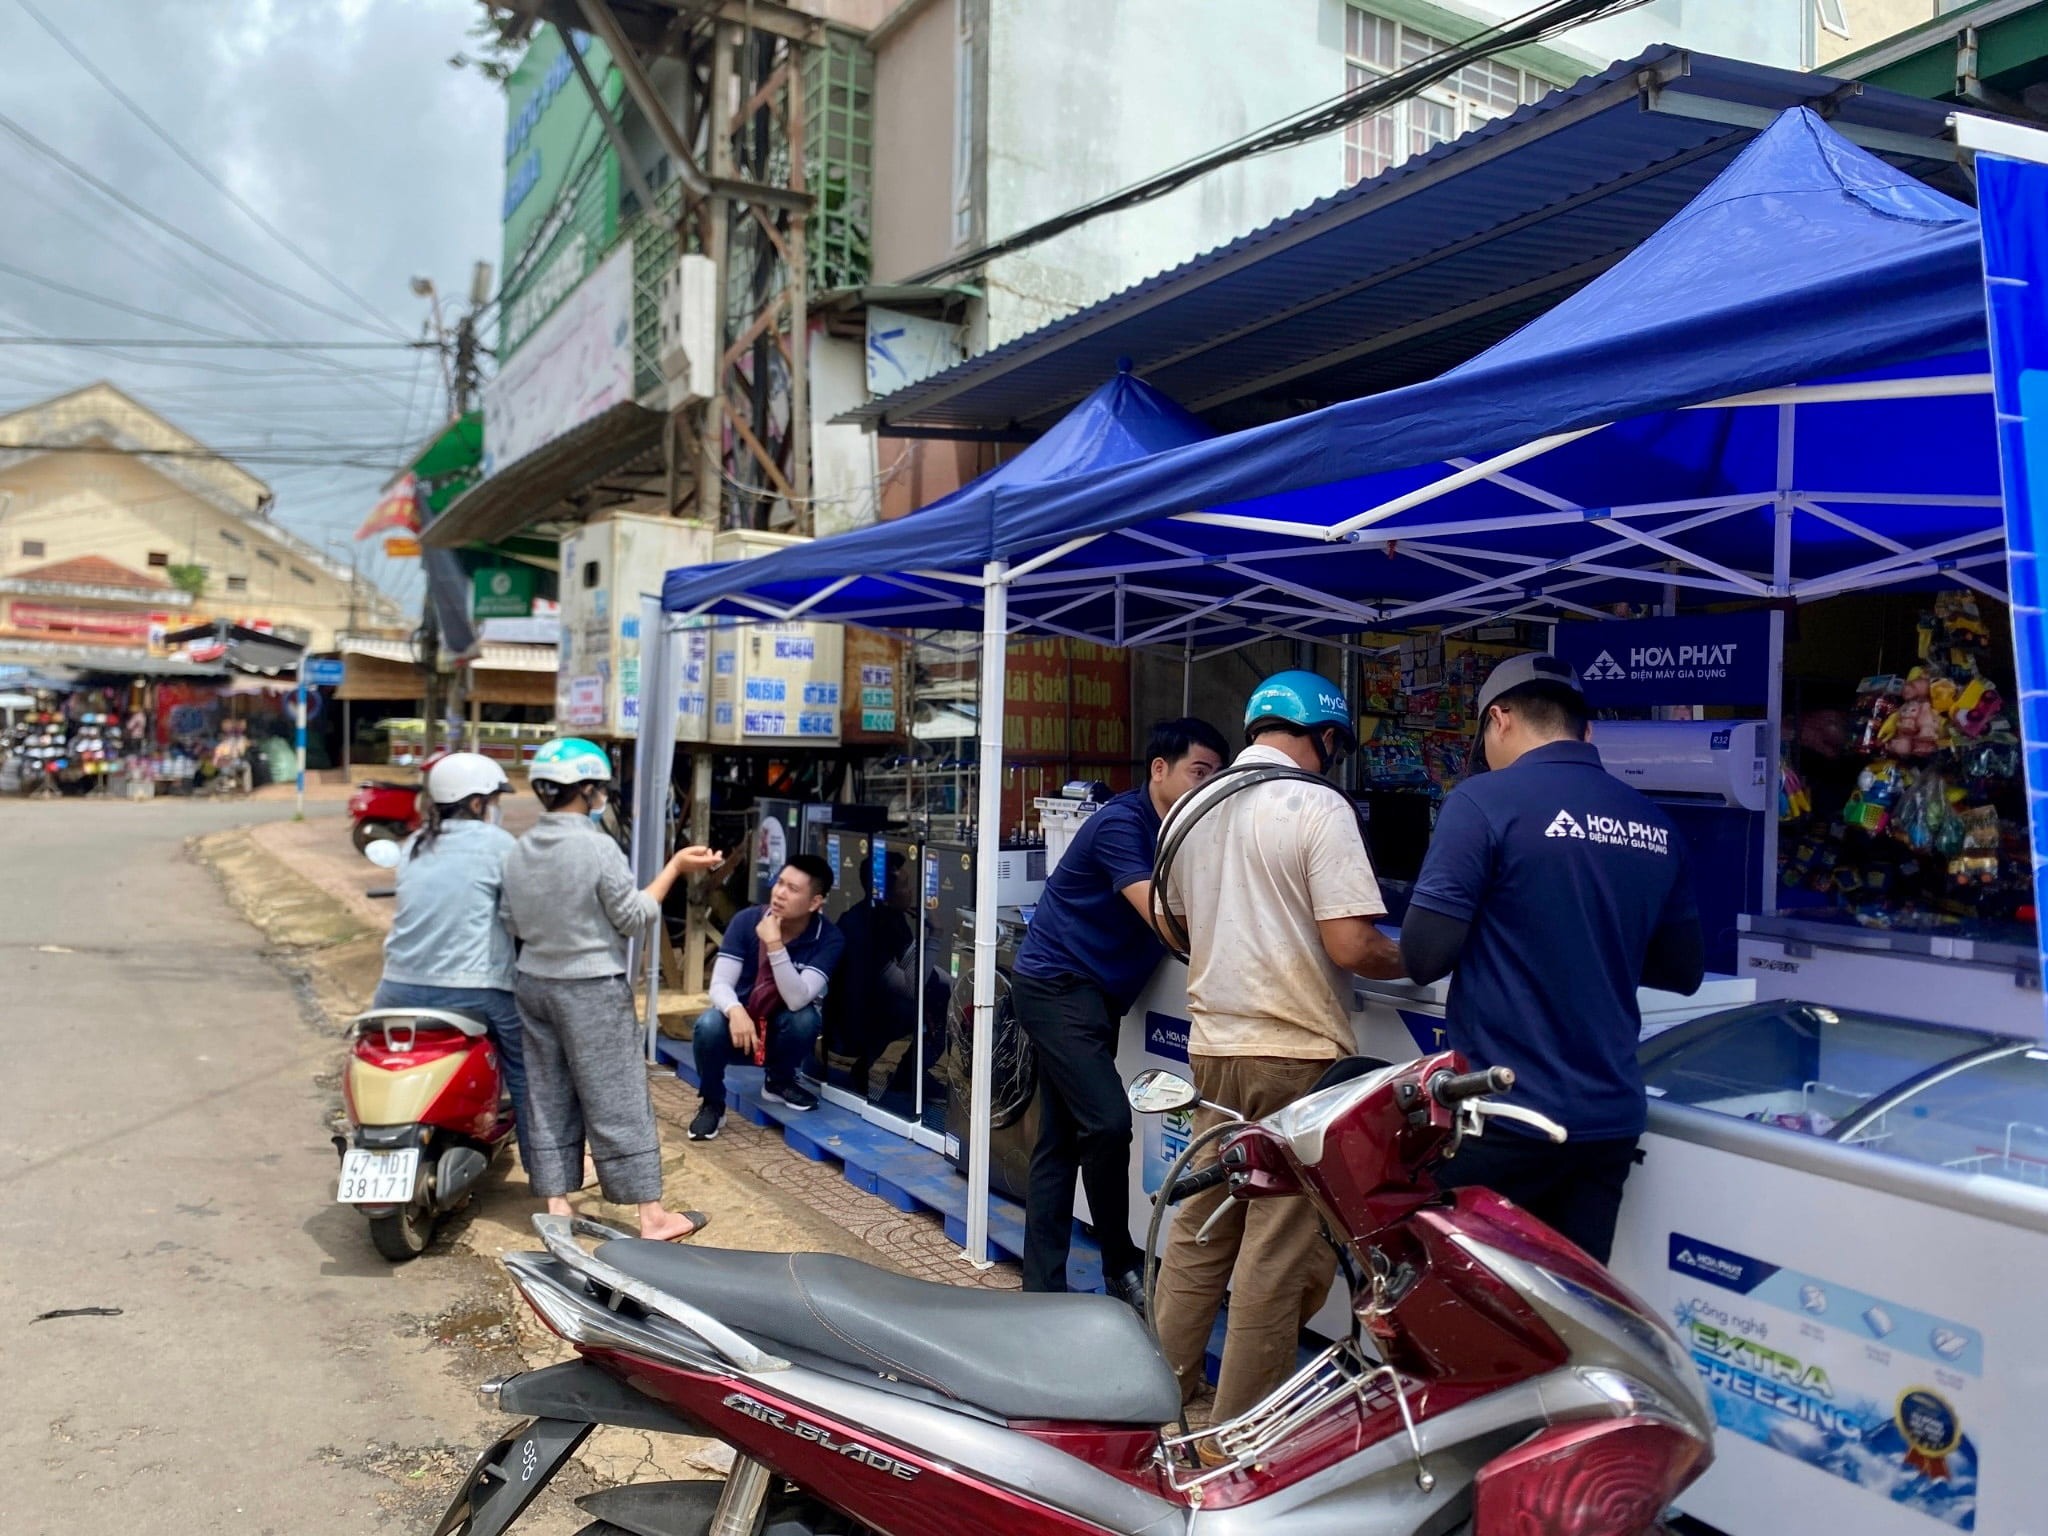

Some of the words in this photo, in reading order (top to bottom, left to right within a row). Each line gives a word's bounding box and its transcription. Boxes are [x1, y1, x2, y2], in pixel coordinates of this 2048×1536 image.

[1630, 669, 1652, 682] ĐIỆN
[1655, 669, 1675, 679] MÁY
[1678, 670, 1694, 679] GIA
[1697, 669, 1726, 680] DỤNG
[1004, 715, 1026, 749] UA
[1713, 735, 1729, 745] R32
[1631, 839, 1647, 849] GIA
[343, 1176, 409, 1199] 381.71
[1691, 1298, 1729, 1327] Công
[1732, 1316, 1768, 1340] nghệ
[1691, 1319, 1833, 1399] EXTRA
[1690, 1349, 1862, 1442] FREEZING
